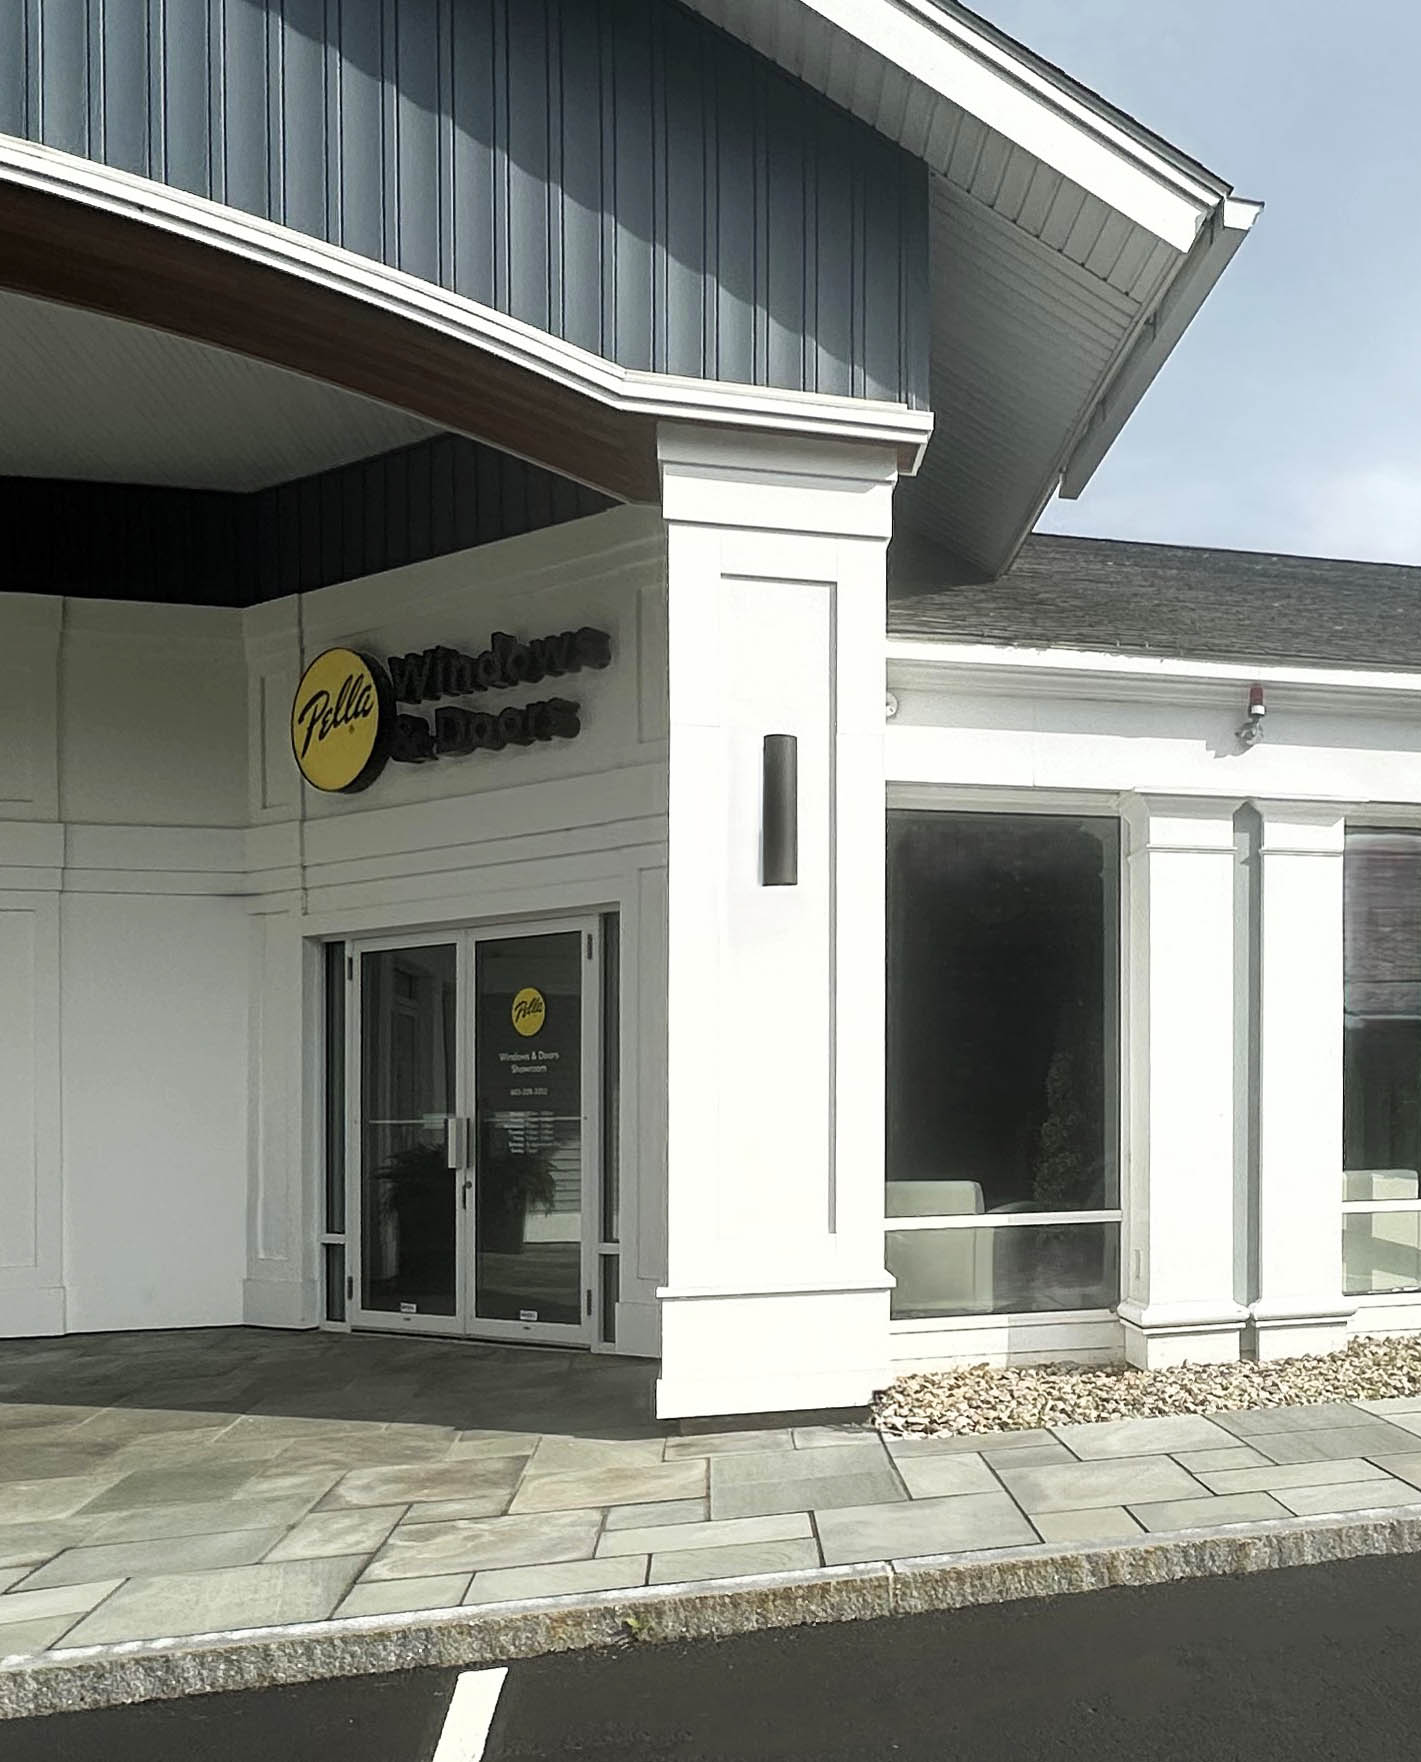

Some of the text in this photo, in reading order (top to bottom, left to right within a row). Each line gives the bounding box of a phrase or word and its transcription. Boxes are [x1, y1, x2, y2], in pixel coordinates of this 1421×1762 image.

[388, 626, 612, 704] Windows
[298, 673, 375, 760] Pella
[435, 697, 581, 757] Doors
[514, 997, 543, 1023] Pella
